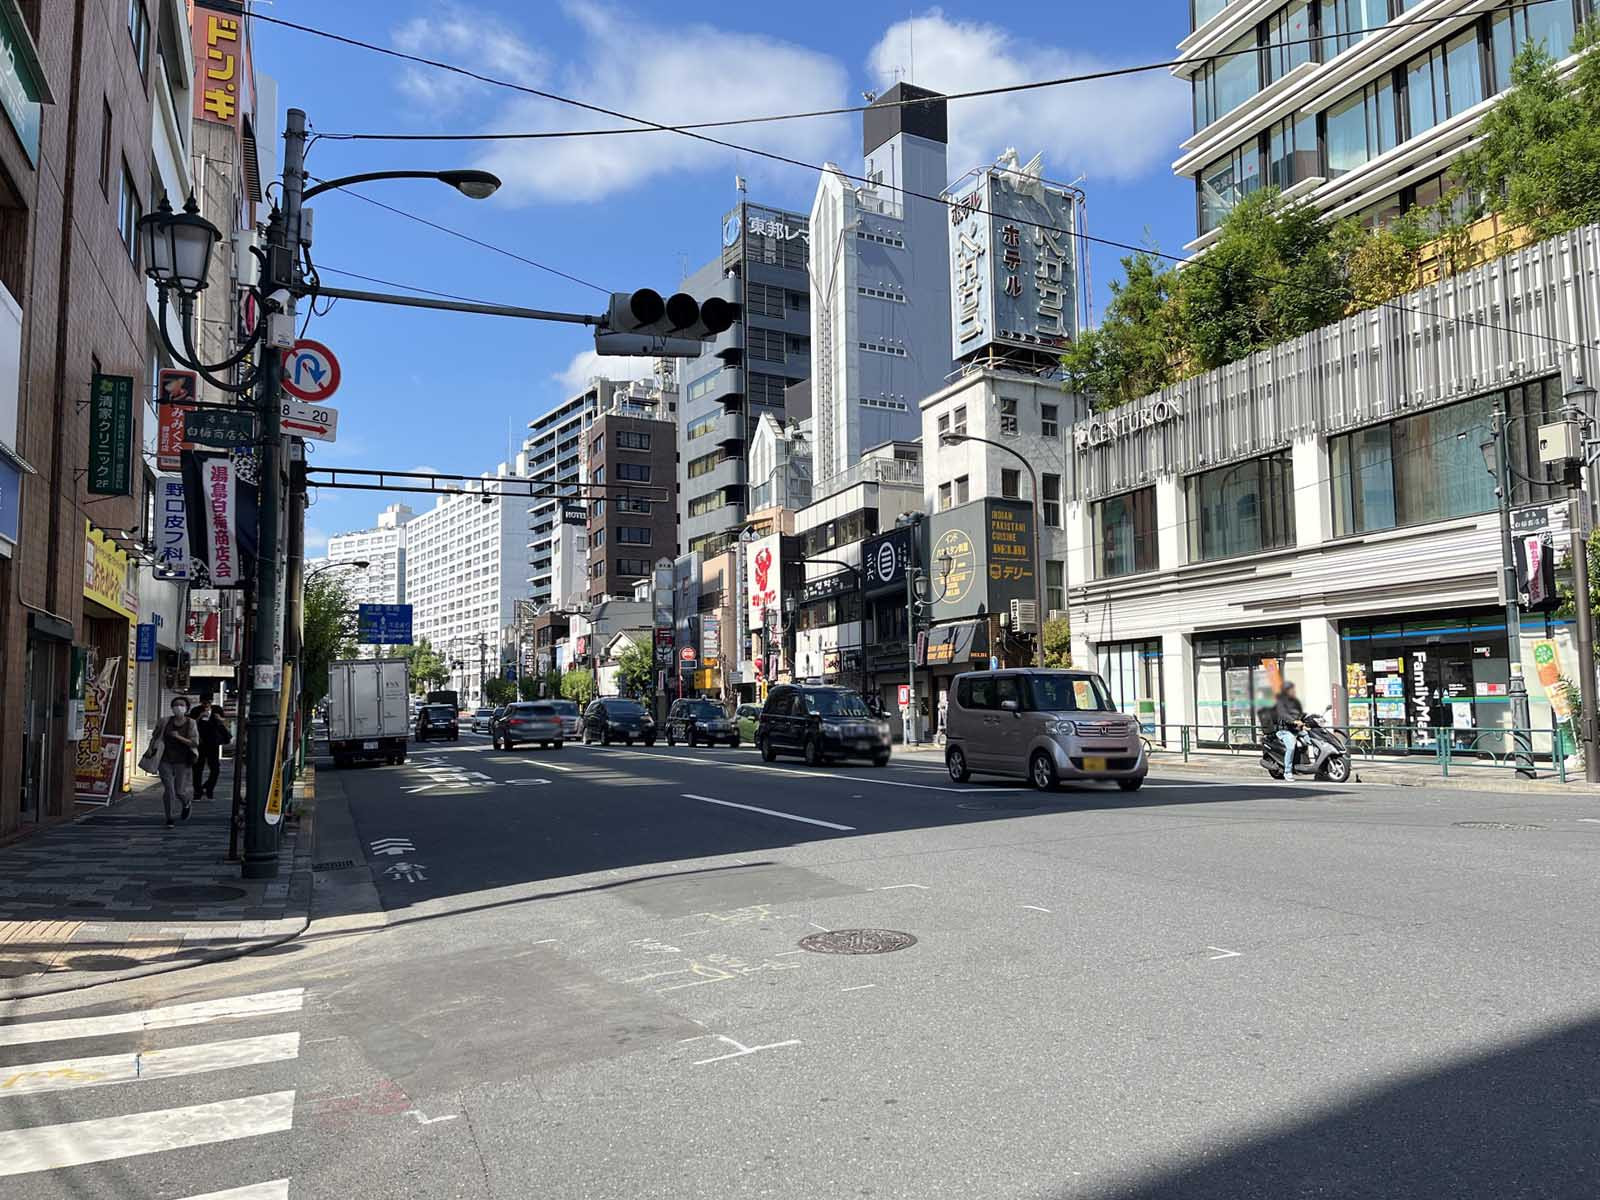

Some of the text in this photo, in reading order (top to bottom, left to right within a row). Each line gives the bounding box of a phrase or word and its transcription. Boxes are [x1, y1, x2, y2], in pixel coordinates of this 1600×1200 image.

[1002, 224, 1023, 297] ホテル
[282, 404, 290, 415] 8
[312, 410, 328, 422] 20
[1088, 393, 1183, 446] CENTURION
[164, 482, 185, 561] 野口皮フ科
[1412, 651, 1434, 746] FamilyMart
